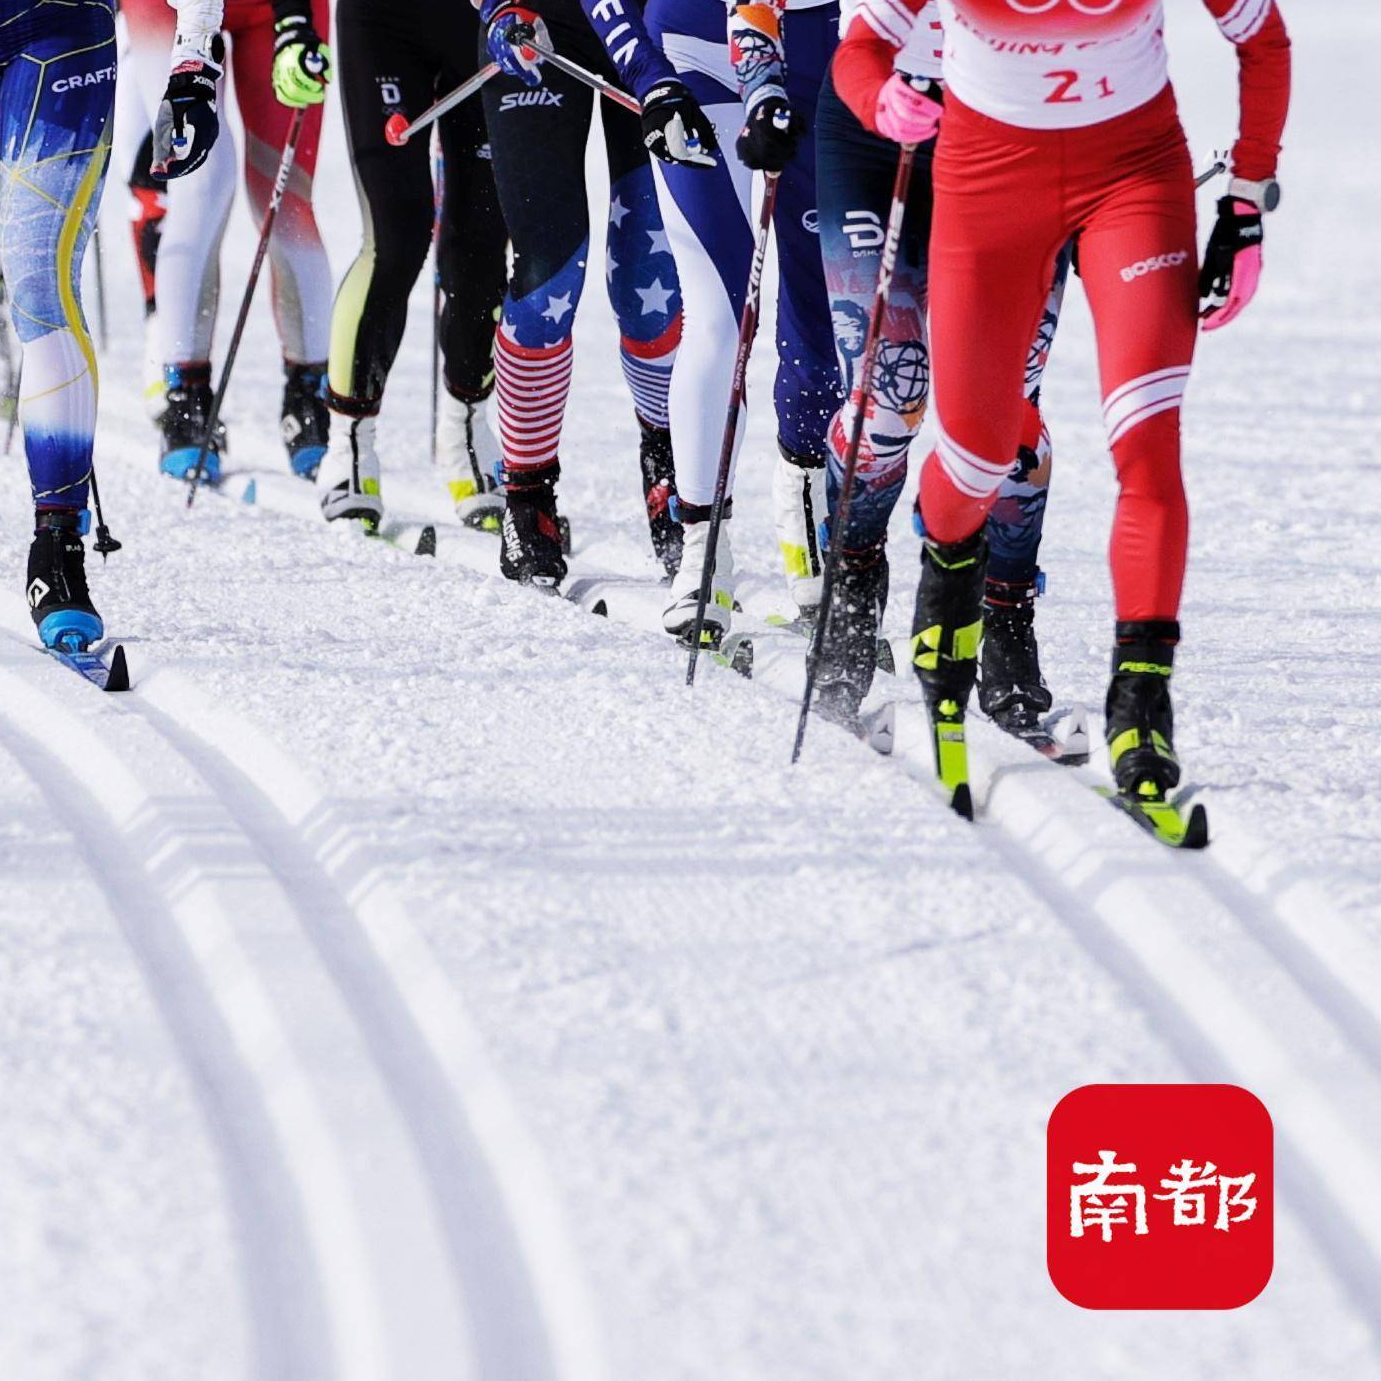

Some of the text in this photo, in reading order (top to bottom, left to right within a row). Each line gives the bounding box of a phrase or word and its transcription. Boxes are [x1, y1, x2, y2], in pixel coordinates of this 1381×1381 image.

[51, 69, 113, 94] CRAFT
[1042, 70, 1115, 104] 2 1
[1120, 252, 1182, 282] BOSCO
